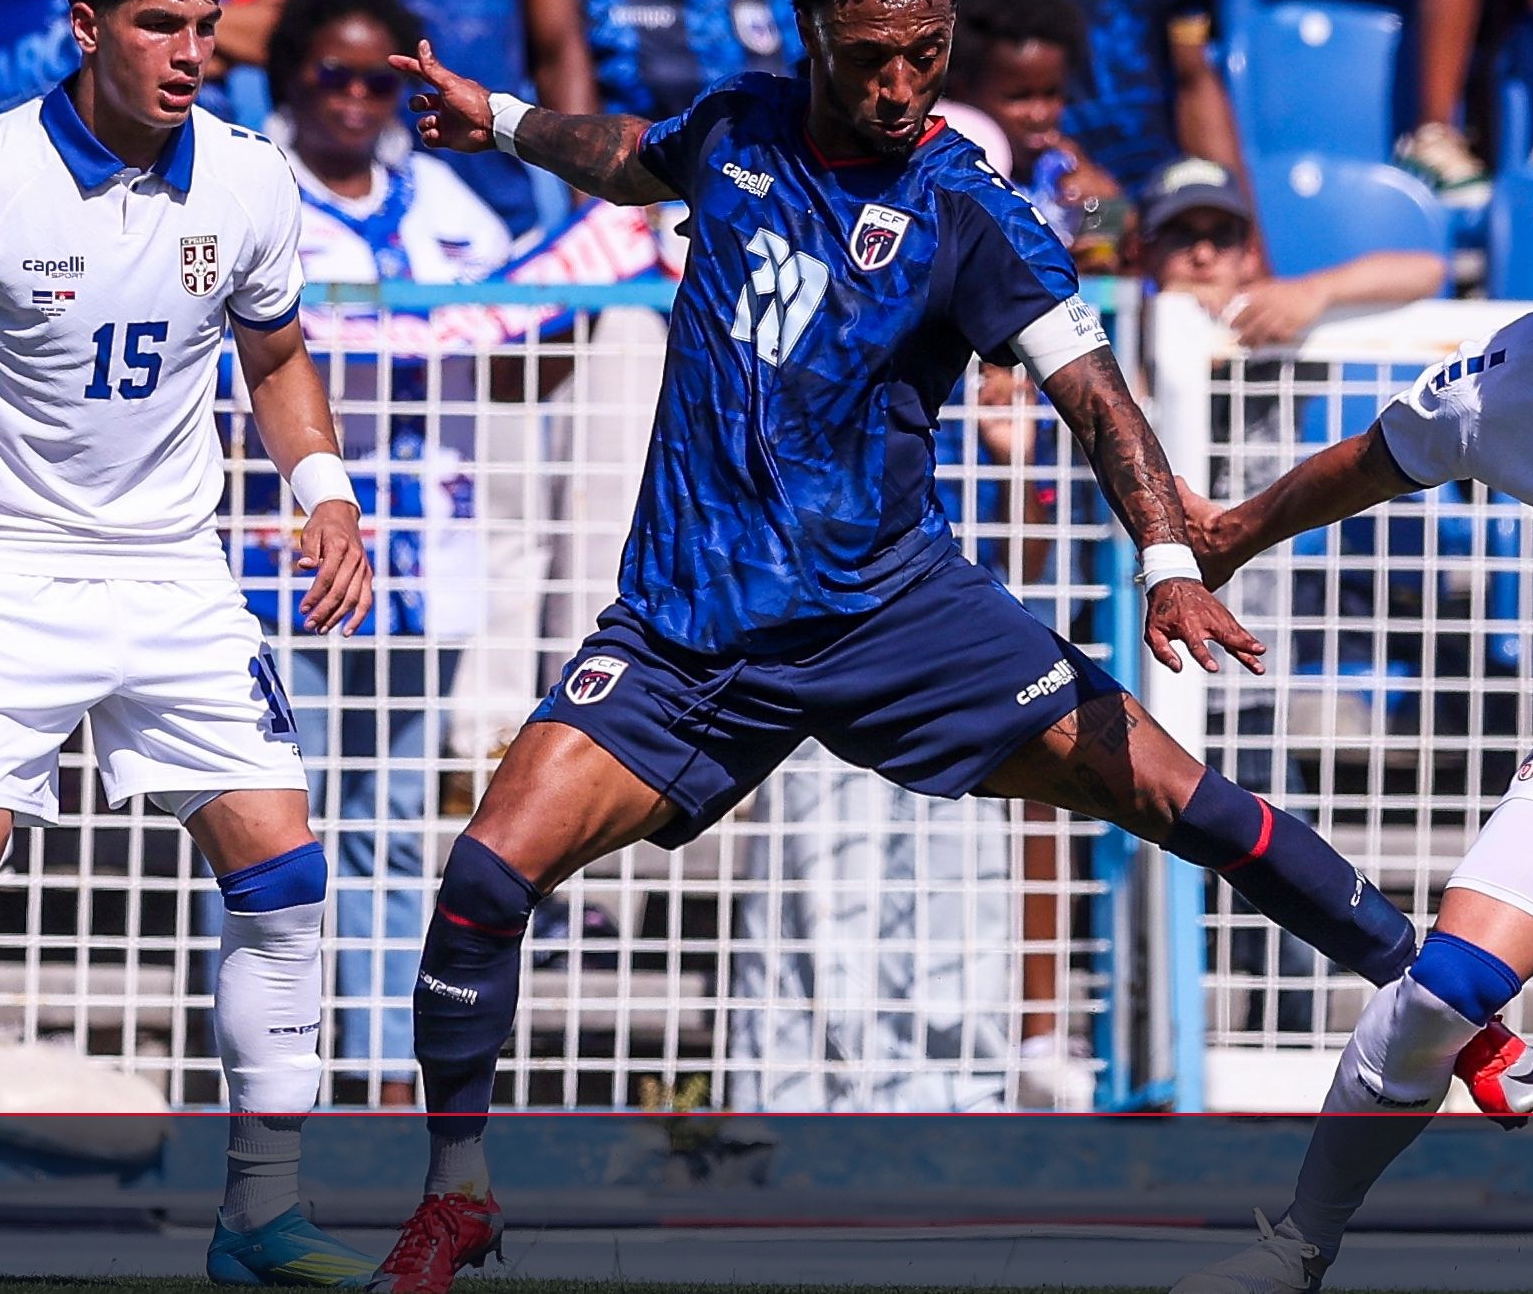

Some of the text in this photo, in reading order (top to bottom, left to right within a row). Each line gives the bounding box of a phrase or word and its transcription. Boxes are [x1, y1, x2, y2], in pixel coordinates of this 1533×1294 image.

[722, 162, 775, 193] capelli
[738, 182, 768, 199] SPORT
[867, 208, 905, 224] FCF
[22, 256, 85, 276] capelli
[84, 321, 169, 400] 15
[586, 658, 623, 669] FCF
[1016, 659, 1074, 705] capelli
